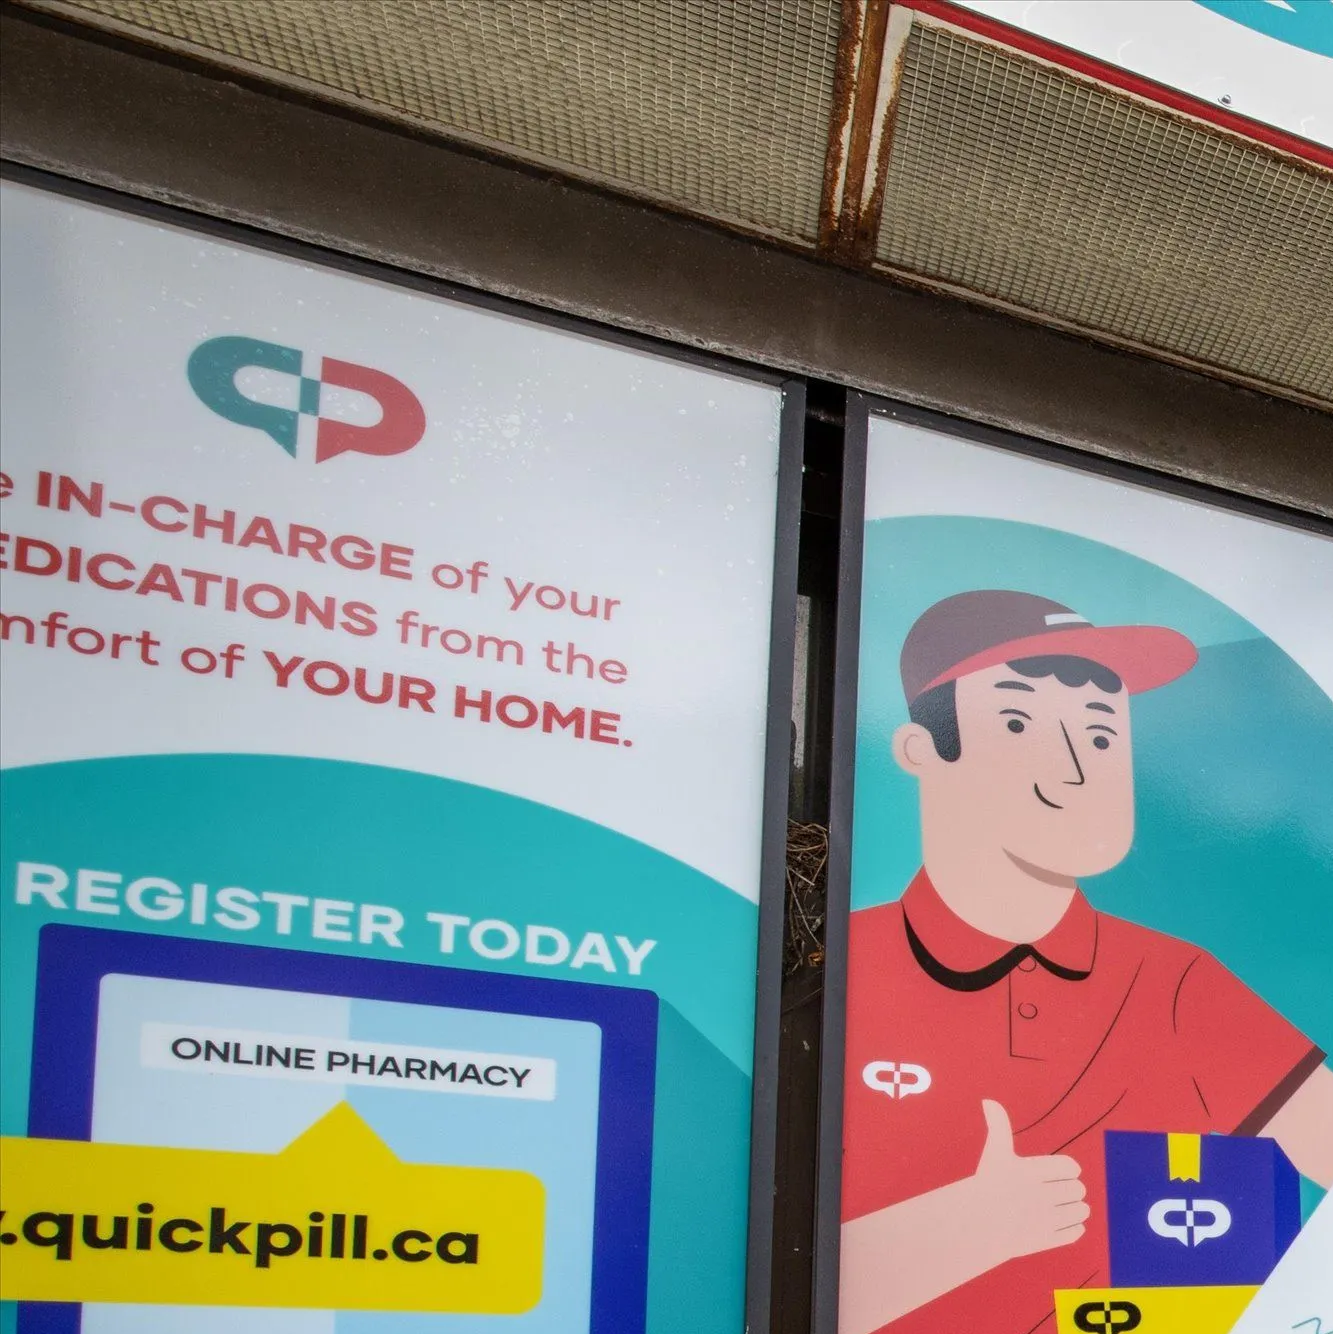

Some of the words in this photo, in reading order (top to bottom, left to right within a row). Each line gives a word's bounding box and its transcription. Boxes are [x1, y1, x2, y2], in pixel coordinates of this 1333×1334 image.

[37, 470, 414, 581] IN-CHARGE
[431, 560, 488, 594] of
[503, 577, 621, 622] your
[397, 611, 523, 666] from
[542, 641, 628, 684] the
[181, 644, 244, 678] of
[264, 650, 435, 714] YOUR
[454, 687, 634, 748] HOME.
[15, 861, 404, 948] REGISTER
[426, 911, 657, 976] TODAY
[170, 1036, 315, 1072] ONLINE
[327, 1048, 532, 1090] PHARMACY
[0, 1201, 479, 1268] .quickpill.ca
